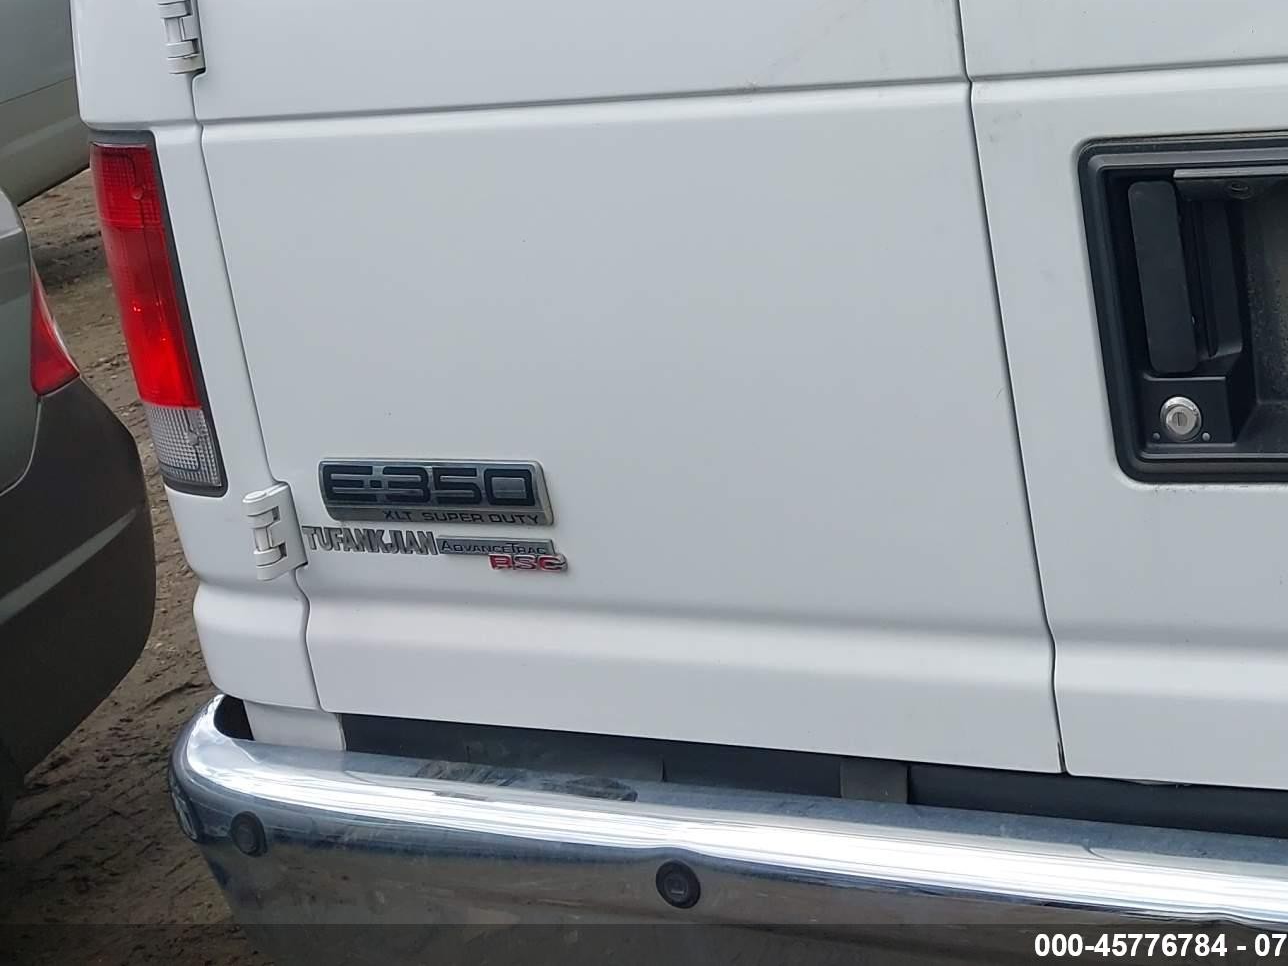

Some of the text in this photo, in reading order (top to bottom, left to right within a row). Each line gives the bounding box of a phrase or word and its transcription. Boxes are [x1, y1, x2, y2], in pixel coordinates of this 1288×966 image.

[322, 465, 536, 506] E-350
[383, 510, 539, 525] XLT SUPER DUTY
